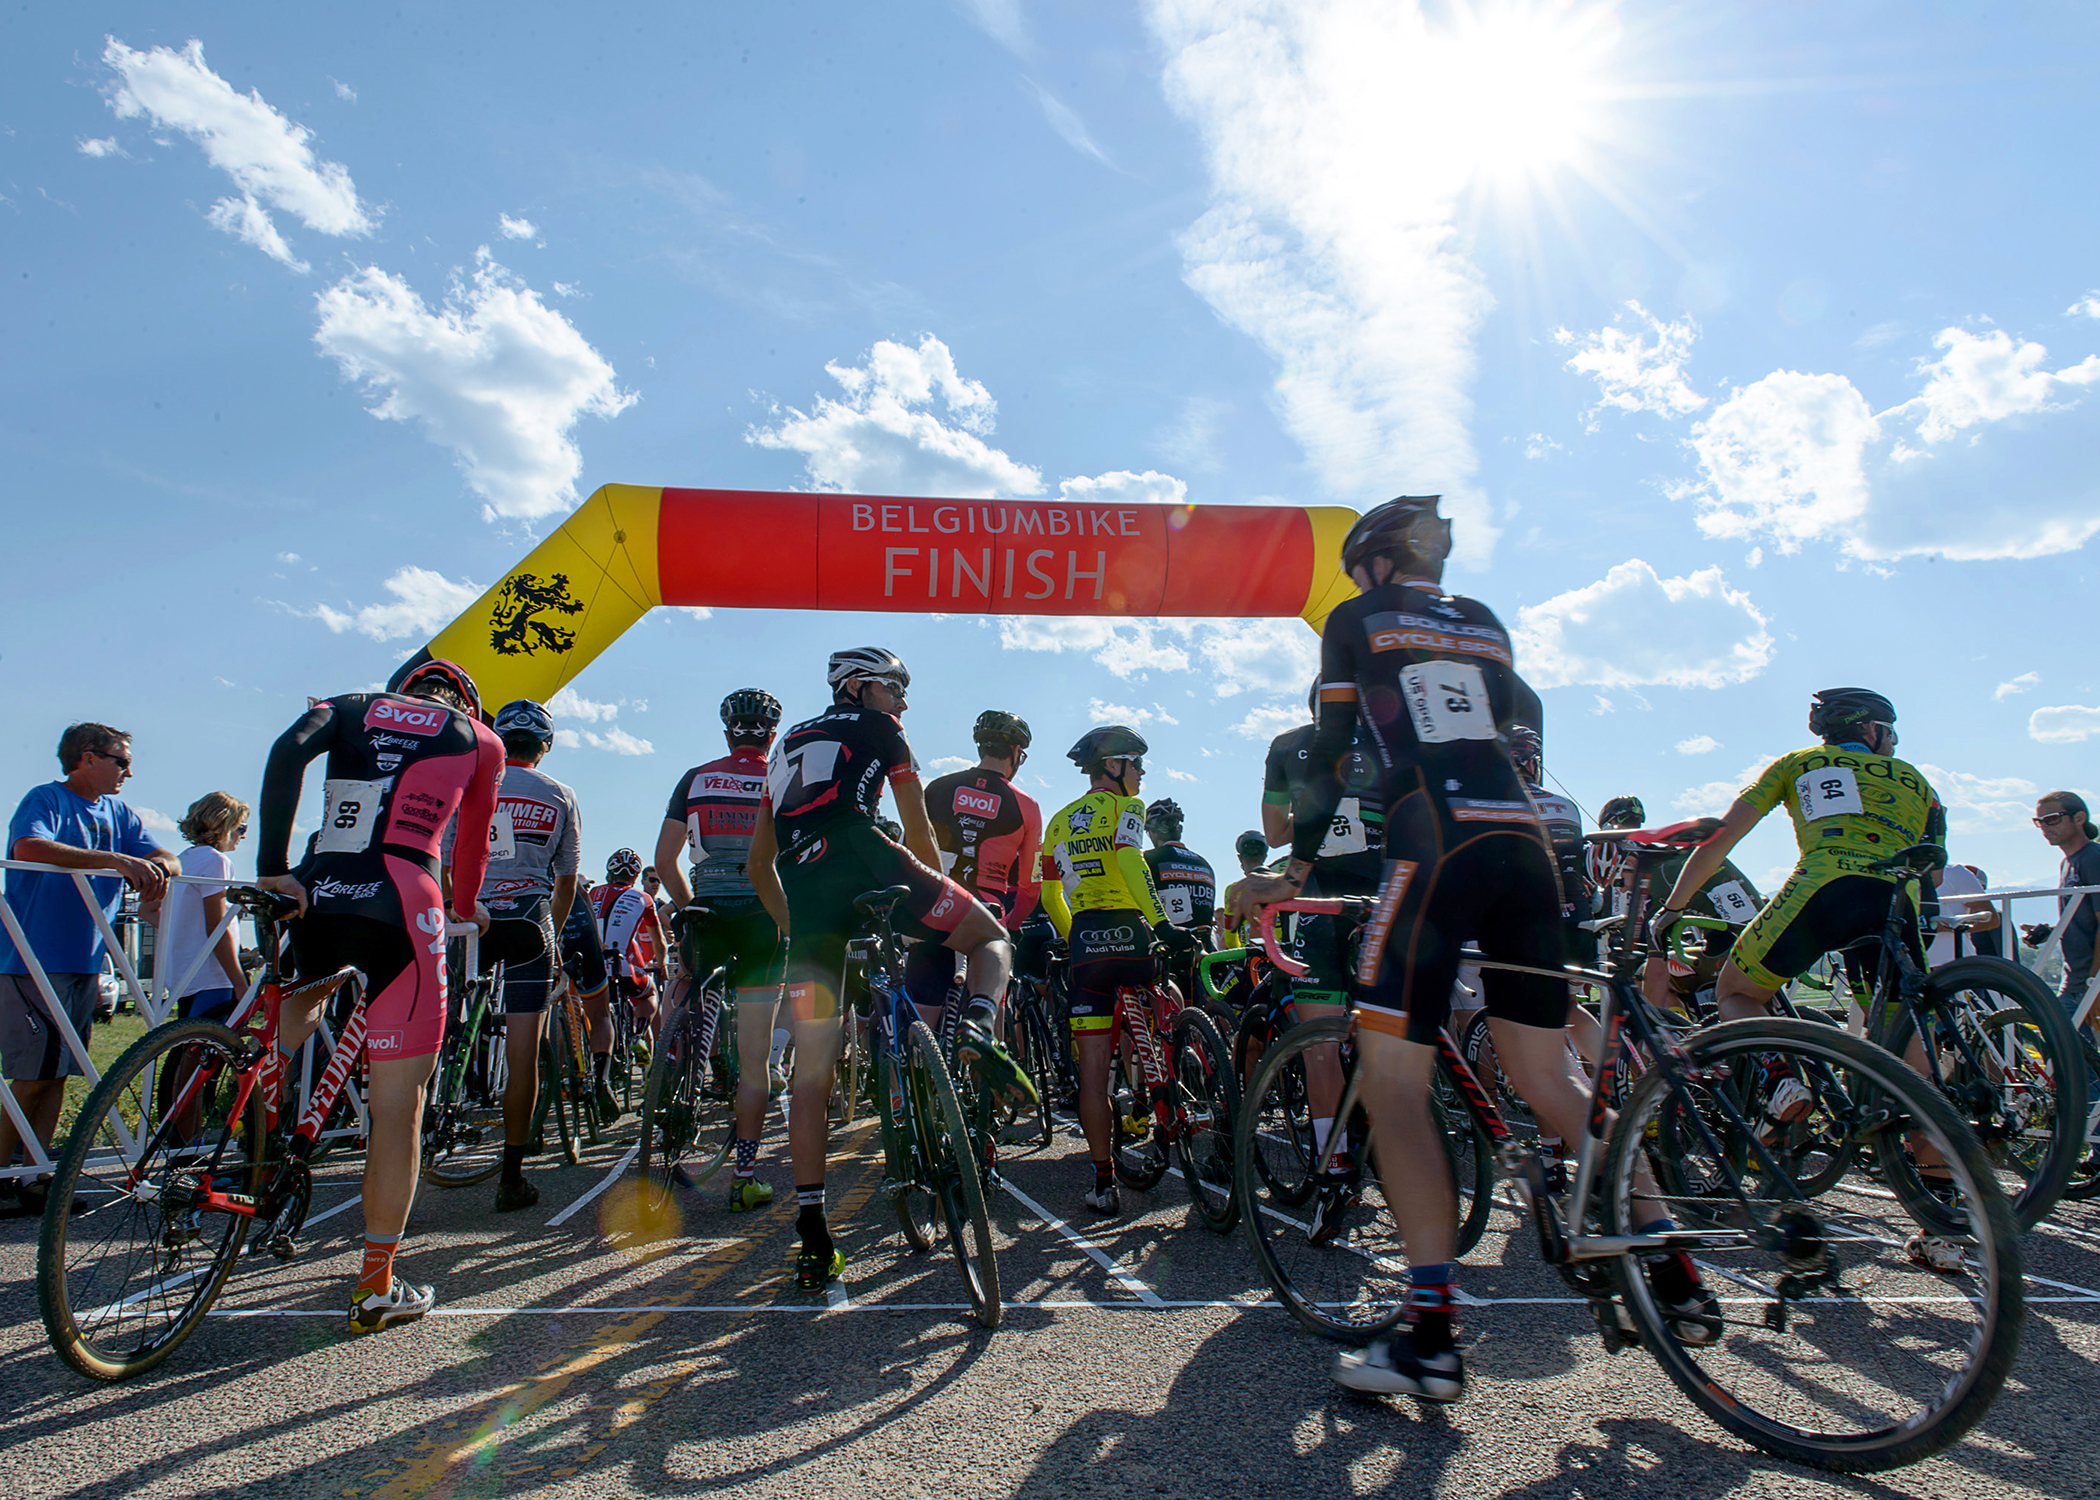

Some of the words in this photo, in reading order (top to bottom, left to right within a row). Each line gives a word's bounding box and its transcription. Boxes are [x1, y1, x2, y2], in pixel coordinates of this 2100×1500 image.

[852, 503, 1140, 537] BELGIUMBIKE
[884, 546, 1106, 600] FINISH
[1438, 681, 1472, 713] 73
[1820, 779, 1845, 800] 64
[1331, 815, 1351, 837] 65
[331, 881, 383, 895] BREEZE
[1171, 898, 1184, 913] 34
[1726, 892, 1746, 909] 56
[1085, 945, 1108, 954] Audi
[1111, 944, 1135, 952] Tulsa
